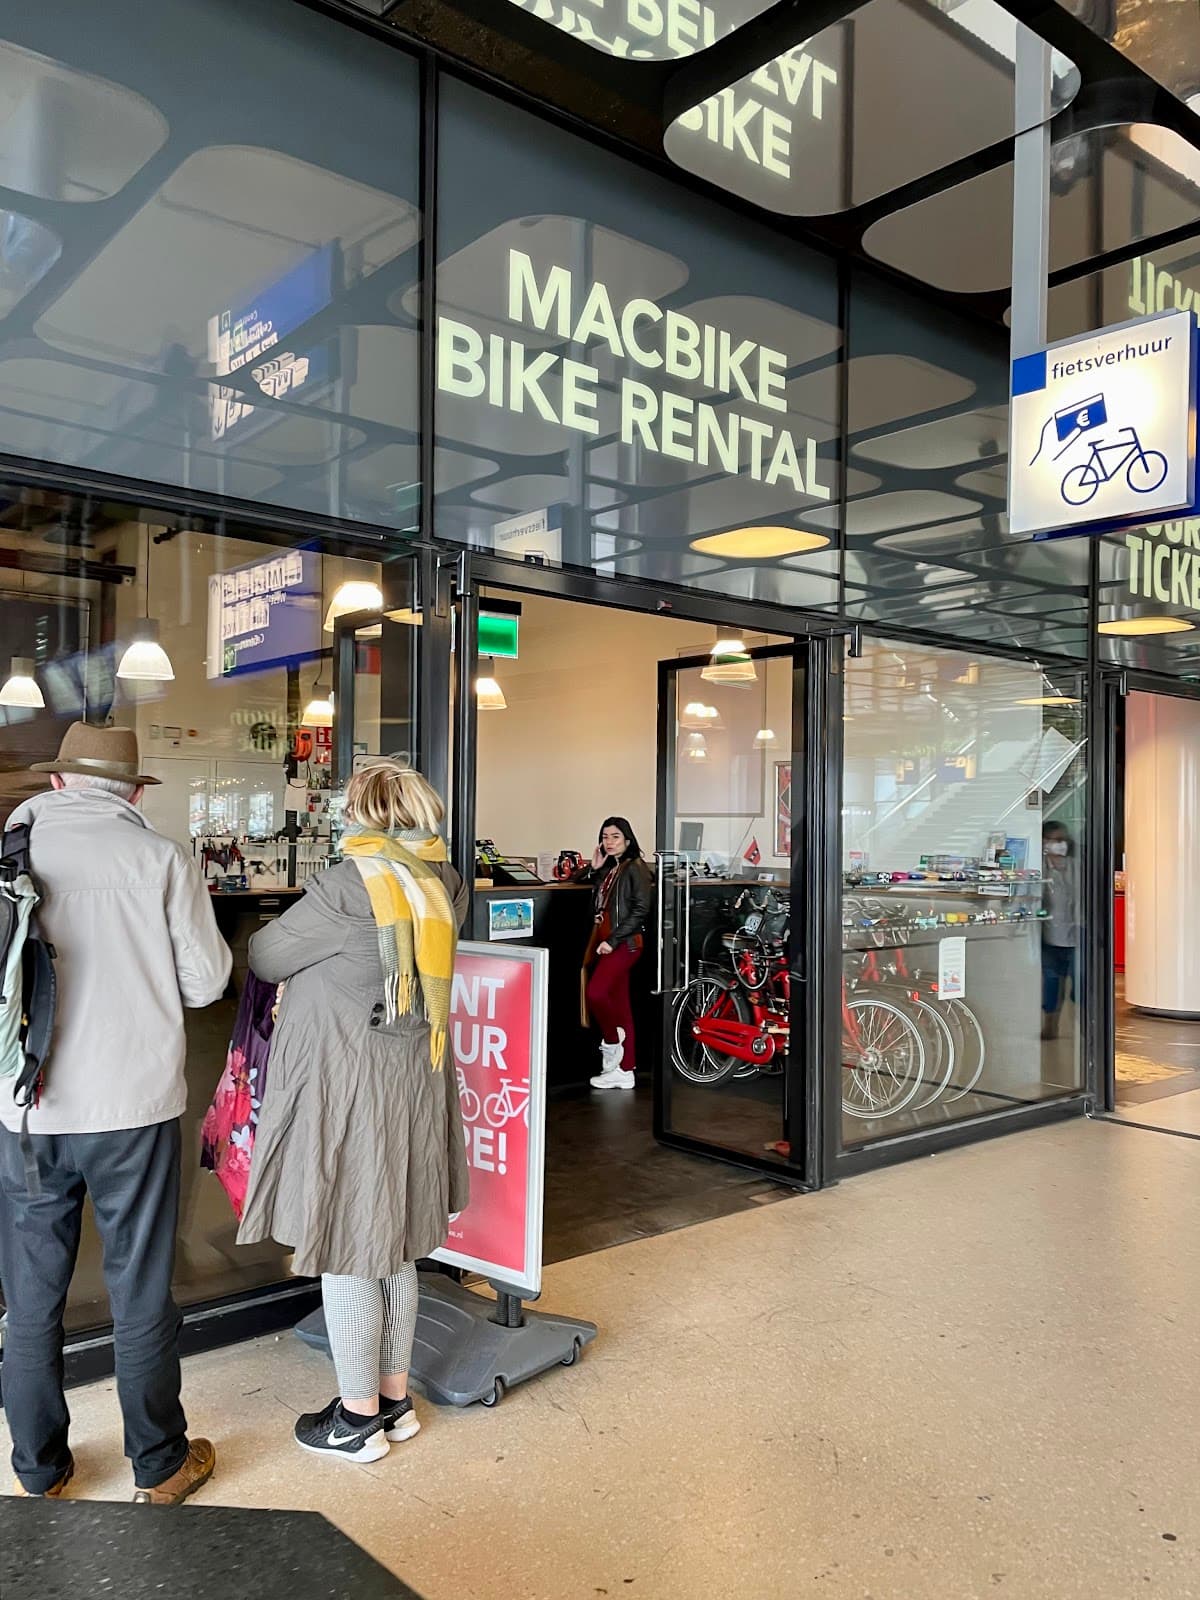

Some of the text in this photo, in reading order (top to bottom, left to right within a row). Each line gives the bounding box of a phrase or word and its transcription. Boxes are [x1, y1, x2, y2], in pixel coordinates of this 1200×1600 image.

[437, 316, 831, 500] BIKE RENTAL
[508, 248, 788, 414] MACBIKE
[1051, 335, 1173, 380] fietsverhuur
